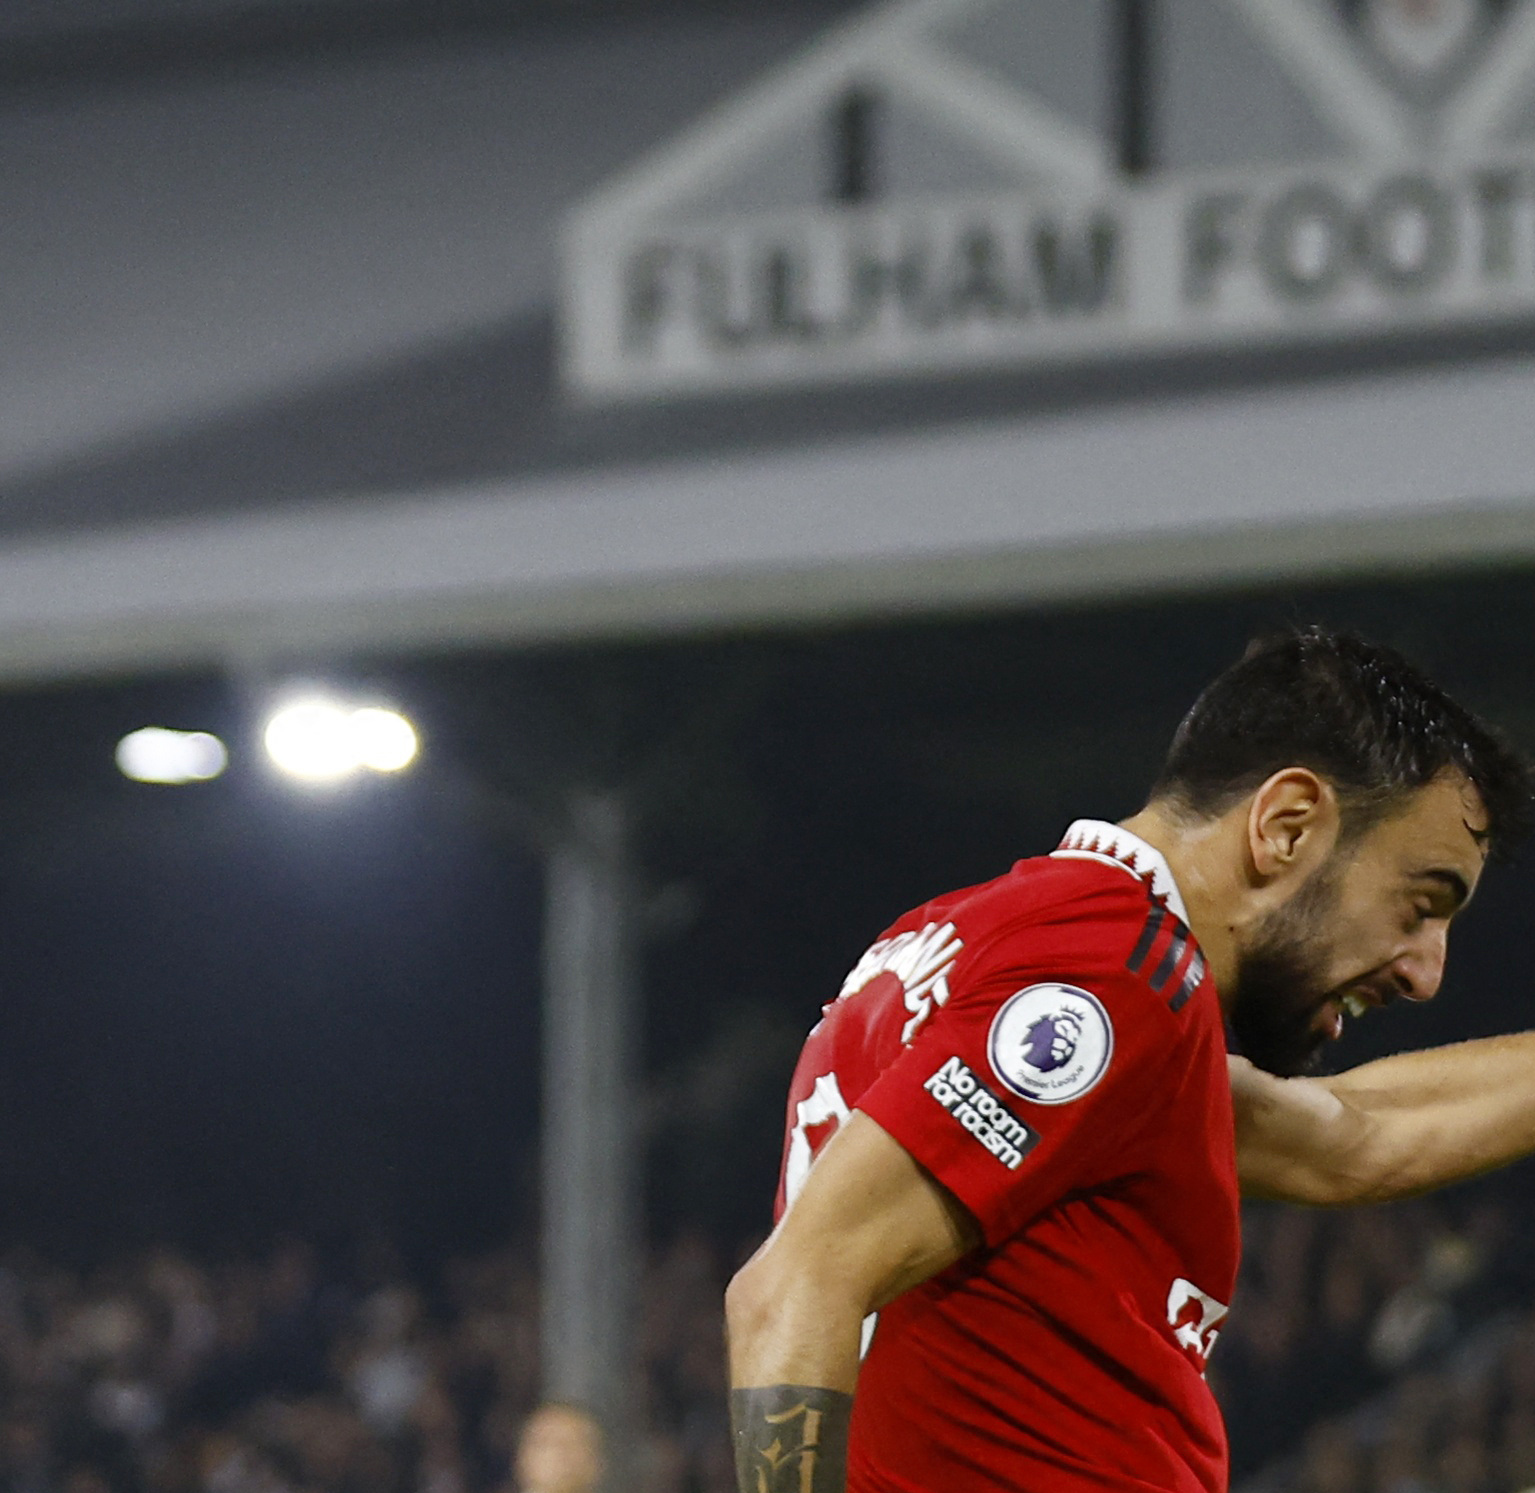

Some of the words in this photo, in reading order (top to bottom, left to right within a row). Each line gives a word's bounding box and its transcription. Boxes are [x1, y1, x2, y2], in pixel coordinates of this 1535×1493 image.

[616, 208, 1125, 358] FULHAM
[923, 1071, 963, 1108] for
[951, 1101, 1025, 1171] racism
[939, 1056, 977, 1095] No
[968, 1088, 1028, 1147] room
